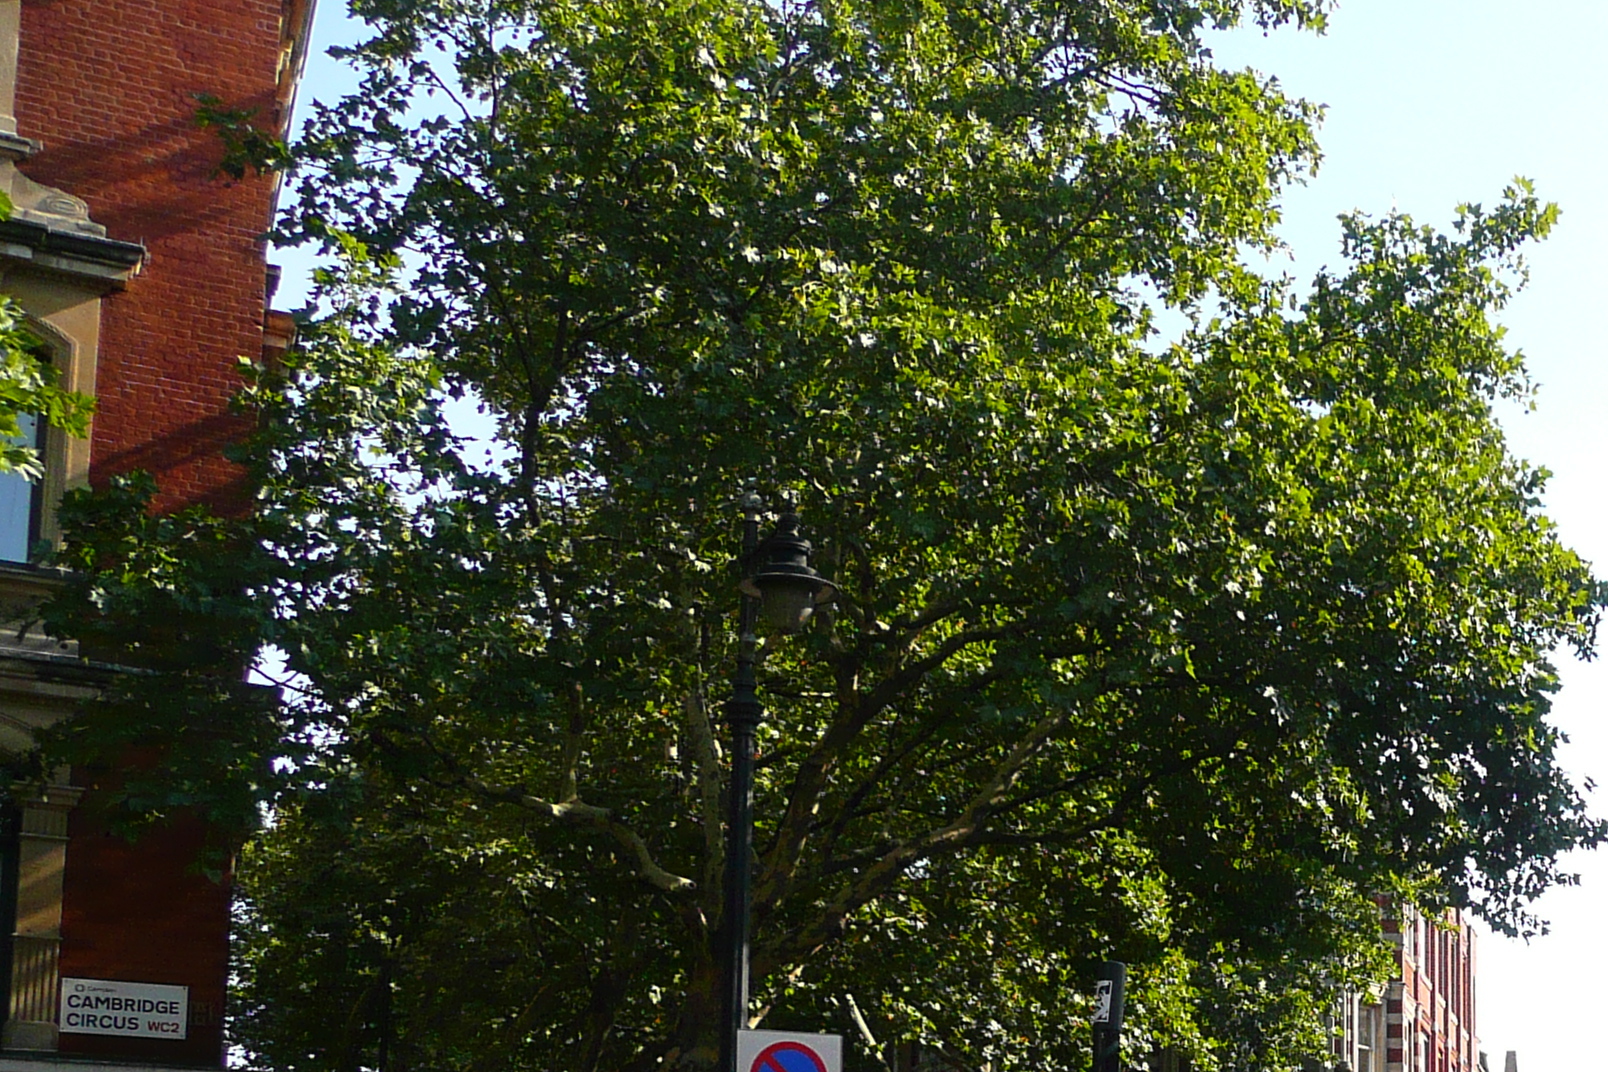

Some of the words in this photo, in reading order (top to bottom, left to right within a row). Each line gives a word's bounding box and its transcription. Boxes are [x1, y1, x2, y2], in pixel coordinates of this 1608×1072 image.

[67, 994, 180, 1015] CAMBRIDGE
[66, 1012, 140, 1031] CIRCUS
[147, 1021, 180, 1033] WC2
